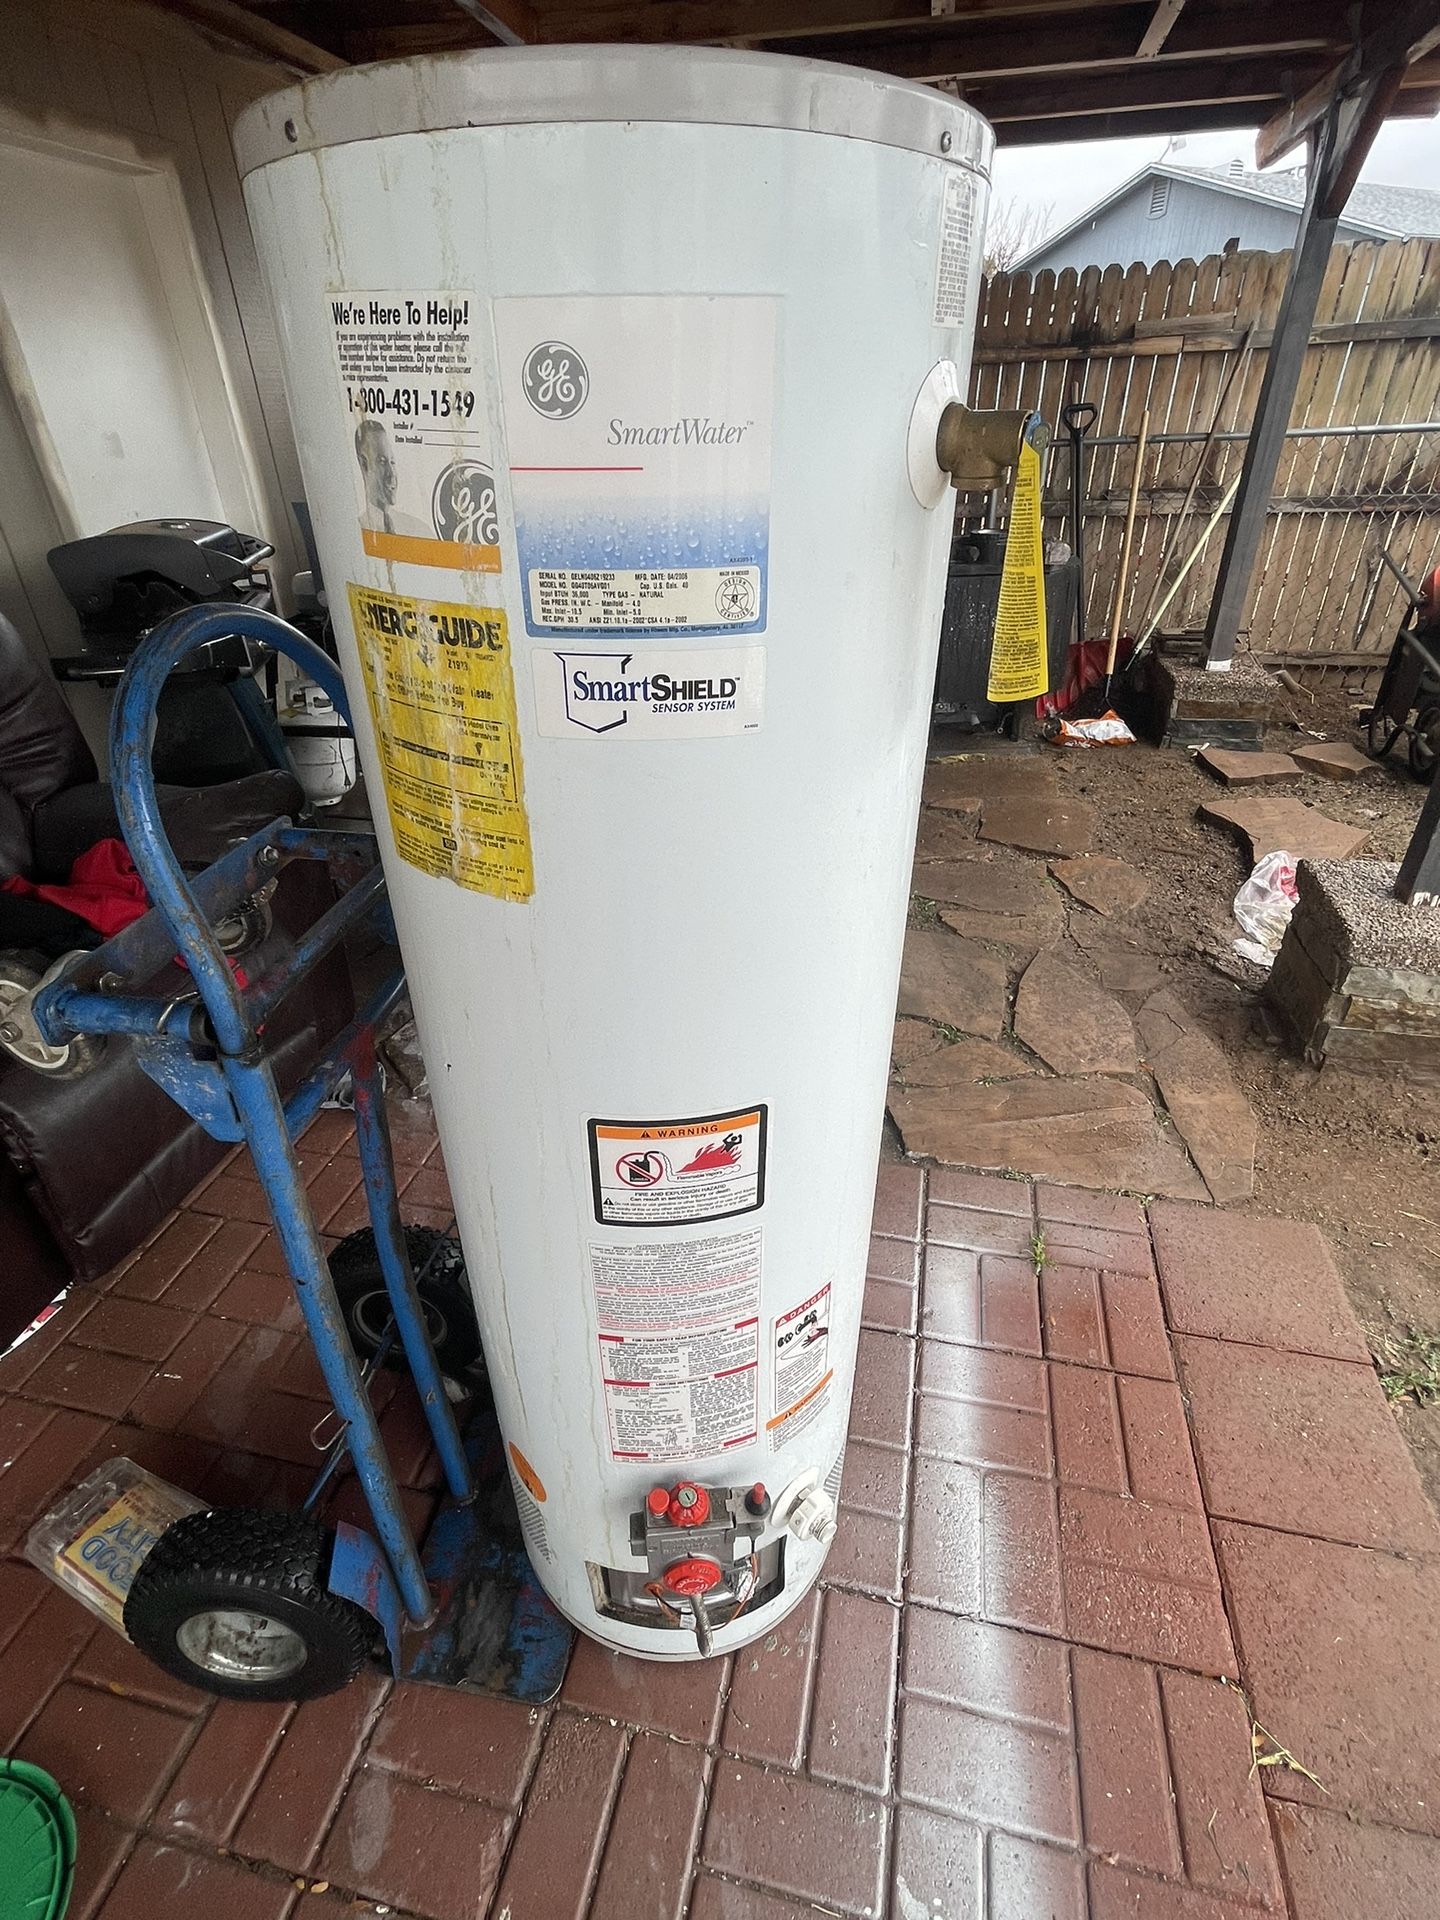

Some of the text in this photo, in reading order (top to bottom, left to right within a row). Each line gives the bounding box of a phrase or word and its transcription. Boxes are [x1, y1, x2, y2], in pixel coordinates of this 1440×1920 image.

[331, 300, 469, 331] We're Here To Help!
[387, 330, 412, 344] problems
[413, 330, 425, 342] with
[426, 330, 436, 342] the
[437, 330, 470, 343] installation
[414, 341, 432, 354] please
[433, 341, 443, 353] call
[417, 352, 425, 363] Do
[426, 353, 436, 363] not
[425, 361, 433, 376] by
[434, 362, 444, 374] the
[538, 571, 557, 581] SERIAL
[558, 572, 567, 581] NO.
[634, 572, 649, 581] MFG.
[650, 573, 666, 581] DATE:
[667, 572, 689, 581] 04/2006
[538, 581, 558, 590] MODEL
[558, 581, 567, 590] NO.
[639, 582, 650, 590] Cap.
[653, 582, 665, 590] U.S.
[682, 581, 689, 590] 40
[539, 590, 664, 599] Input BTUH 36,000 TYPE GAS NATURAL
[540, 598, 551, 606] Gas
[632, 599, 641, 608] 4.0
[541, 606, 553, 615] Max.
[602, 607, 615, 616] Min.
[567, 616, 579, 624] 30.5
[588, 616, 602, 625] ANSI
[651, 699, 736, 714] SENSOR SYSTEM
[657, 1124, 719, 1138] WARNING
[705, 1170, 723, 1178] Vapors
[664, 1187, 701, 1197] EXPLOSION
[701, 1183, 727, 1192] HAZARD
[690, 1191, 707, 1199] injury
[789, 1284, 830, 1321] DANGER
